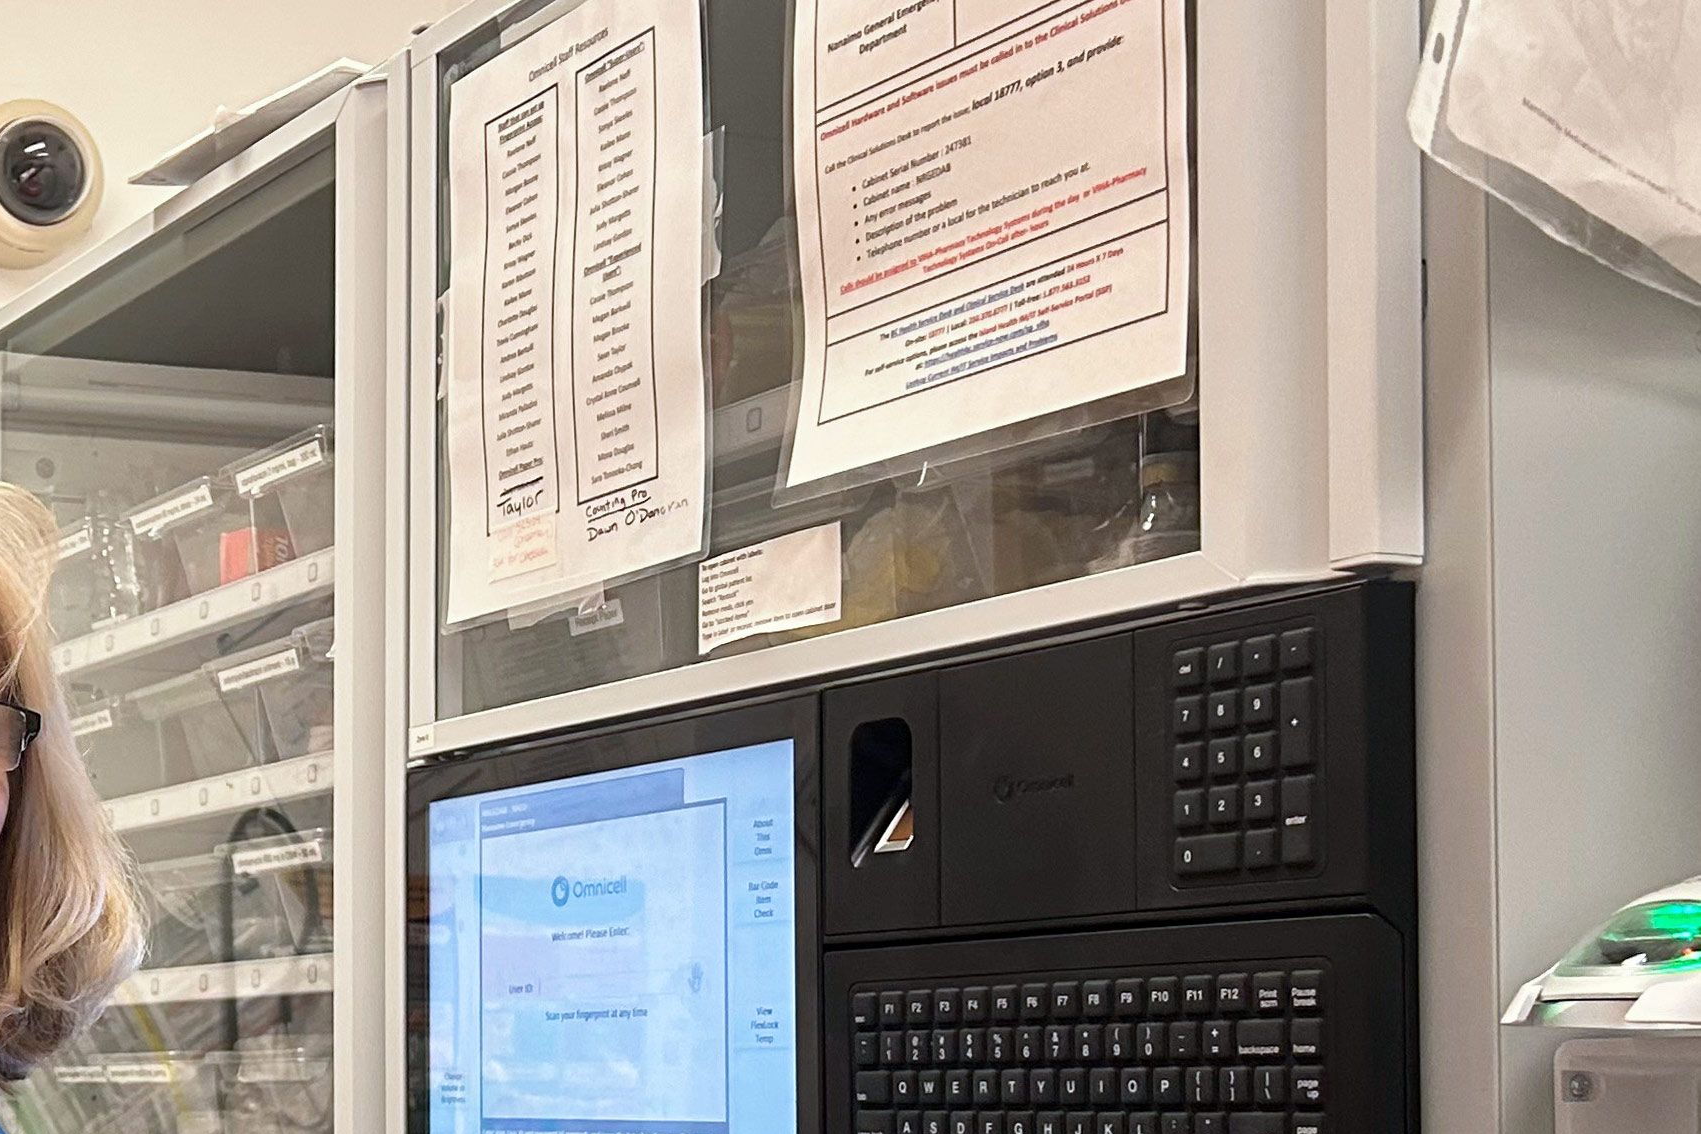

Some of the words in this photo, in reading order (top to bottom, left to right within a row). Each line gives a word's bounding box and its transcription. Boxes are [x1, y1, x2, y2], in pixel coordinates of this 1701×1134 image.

[827, 30, 862, 53] Nanaimo
[864, 11, 895, 35] General
[859, 24, 907, 55] Department
[529, 55, 557, 82] Omnicell
[558, 45, 574, 66] Staff
[575, 27, 608, 55] Resources
[820, 120, 850, 141] Omnicell
[851, 107, 885, 127] Hardware
[886, 98, 900, 112] and
[902, 85, 934, 105] Software
[936, 74, 958, 90] issues
[959, 64, 978, 79] must
[979, 60, 990, 70] be
[990, 46, 1014, 65] called
[1015, 44, 1023, 54] in
[1024, 40, 1034, 49] to
[1034, 32, 1047, 45] the
[1049, 16, 1079, 38] Clinical
[1080, 0, 1118, 24] Solutions
[825, 163, 835, 174] Call
[836, 160, 847, 169] the
[847, 149, 868, 165] Clinical
[869, 139, 896, 156] Solutions
[897, 131, 912, 144] Desk
[912, 128, 920, 137] to
[920, 119, 940, 133] report
[941, 115, 952, 124] the
[972, 91, 993, 111] local
[1025, 67, 1054, 87] option
[1067, 49, 1085, 68] and
[862, 171, 889, 189] Cabinet
[889, 162, 909, 178] Serial
[910, 150, 939, 169] Number
[863, 189, 889, 207] Cabinet
[891, 181, 910, 195] name
[864, 213, 878, 224] Any
[879, 205, 896, 219] error
[897, 191, 932, 211] messages
[866, 239, 903, 258] Telephone
[903, 227, 931, 244] number
[932, 223, 940, 233] or
[947, 212, 964, 227] local
[965, 209, 976, 219] for
[977, 204, 990, 215] the
[991, 187, 1030, 209] technician
[1031, 183, 1040, 194] to
[1041, 173, 1062, 189] reach
[1064, 168, 1078, 182] you
[865, 220, 904, 242] Description
[905, 214, 913, 226] of
[914, 211, 926, 222] the
[927, 199, 958, 219] problem
[496, 489, 544, 517] Taylor
[585, 495, 626, 517] Counting
[631, 489, 648, 500] Pro
[586, 522, 618, 542] Dawn
[1216, 704, 1225, 717] 8
[1252, 697, 1261, 711] 9
[1181, 709, 1190, 722] 7
[1217, 751, 1225, 764] 5
[1253, 745, 1262, 759] 6
[1182, 757, 1190, 768] 4
[1217, 799, 1226, 812] 2
[1254, 794, 1262, 807] 3
[1183, 804, 1190, 816] 1
[753, 819, 774, 828] About
[756, 833, 770, 842] This
[754, 846, 772, 856] Omni
[1183, 849, 1192, 863] 0
[572, 874, 627, 898] Omnicell
[748, 882, 759, 891] Bar
[760, 881, 779, 890] Code
[755, 895, 771, 905] Item
[754, 909, 774, 918] Check
[551, 930, 584, 942] Welcome!
[585, 928, 608, 939] Please
[508, 984, 523, 994] User
[545, 1011, 560, 1021] Scan
[560, 1012, 575, 1023] your
[576, 1009, 610, 1022] fingerprint
[611, 1008, 618, 1018] at
[618, 1009, 631, 1020] any
[632, 1006, 648, 1017] time
[756, 1006, 773, 1016] View
[755, 1034, 774, 1044] Temp
[898, 1081, 908, 1094] Q
[923, 1081, 935, 1094] W
[951, 1080, 960, 1095] E
[979, 1080, 988, 1094] R
[1007, 1080, 1016, 1094] T
[1036, 1080, 1046, 1094] Y
[1066, 1080, 1076, 1094] U
[1127, 1079, 1138, 1094] O
[1160, 1079, 1170, 1093] P
[902, 1121, 912, 1134] A
[929, 1121, 938, 1134] S
[956, 1121, 966, 1134] D
[985, 1121, 993, 1134] F
